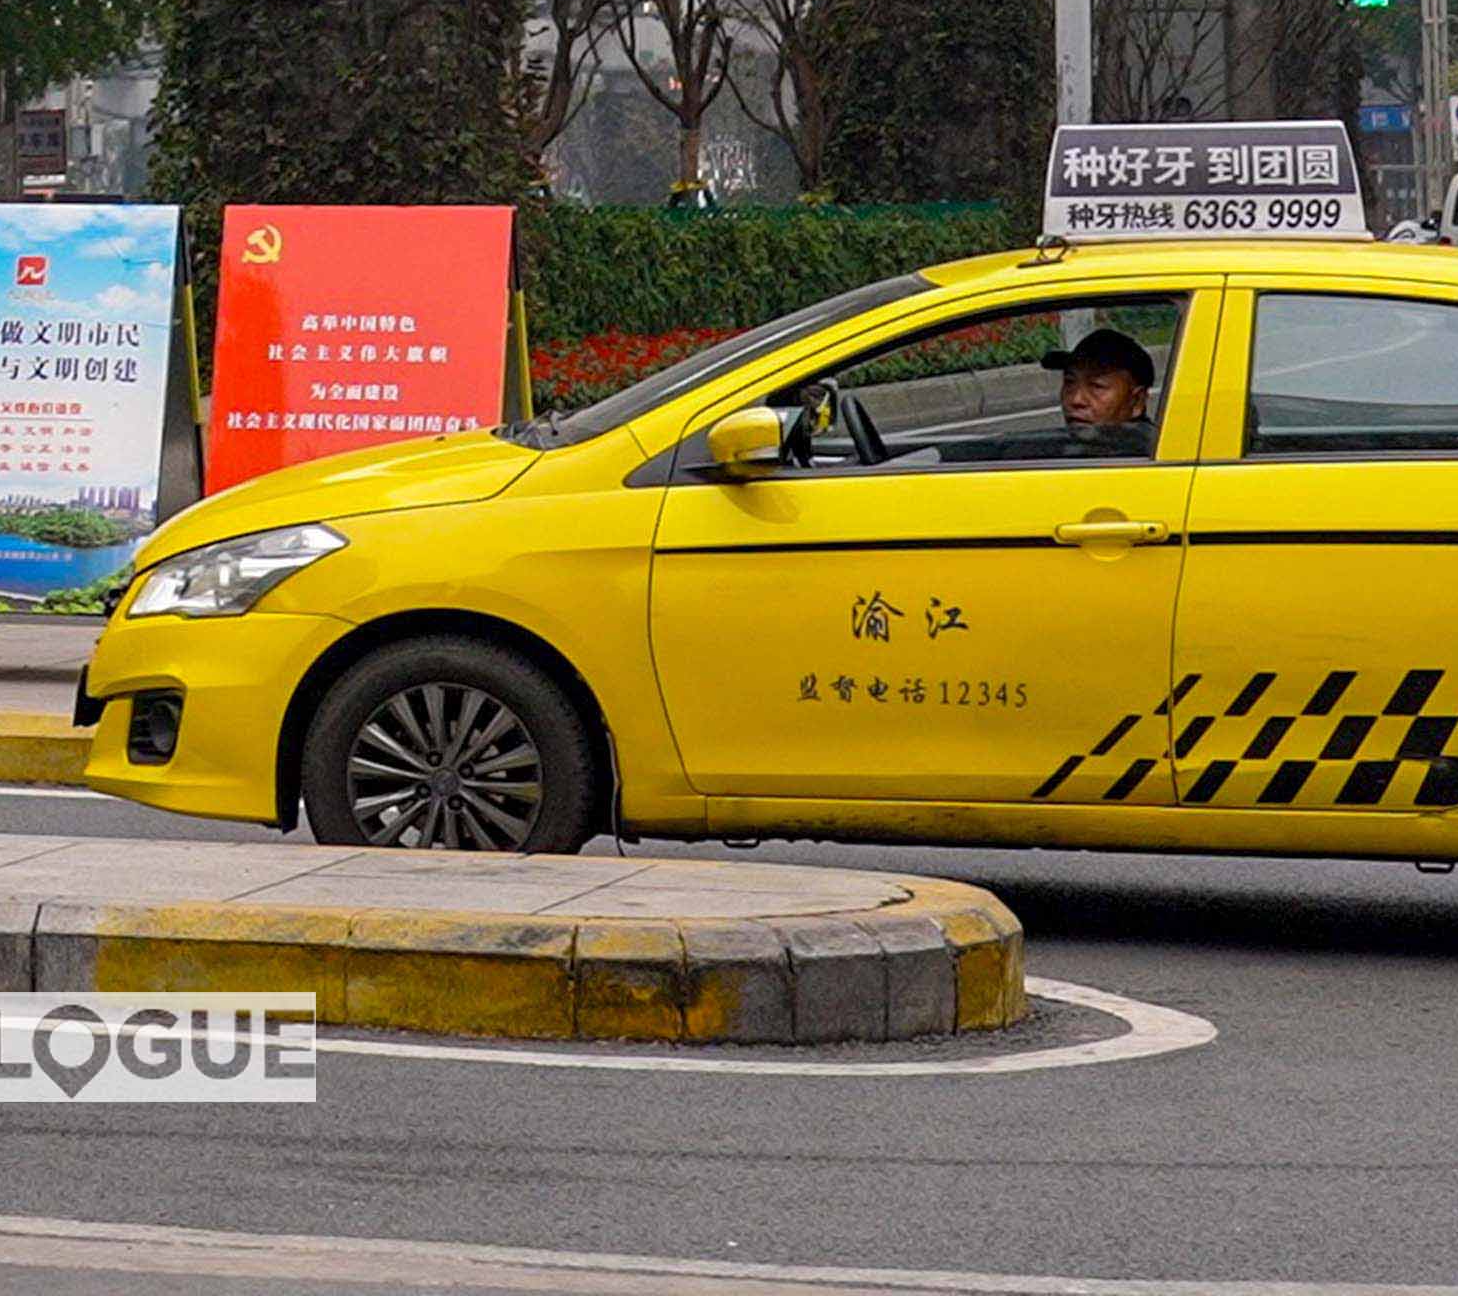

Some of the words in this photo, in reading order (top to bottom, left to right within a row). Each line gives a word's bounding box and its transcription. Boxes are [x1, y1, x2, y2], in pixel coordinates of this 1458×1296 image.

[1063, 145, 1195, 188] 种好牙
[1206, 145, 1341, 187] 到团圆
[1068, 201, 1176, 230] 种牙热线
[1183, 199, 1257, 230] 6363
[1267, 199, 1342, 229] 9999
[301, 314, 417, 332] 高举中国特色
[268, 344, 449, 363] 社会主义伟大旗帜
[310, 383, 400, 401] 为全面建设
[851, 590, 969, 643] 渝江
